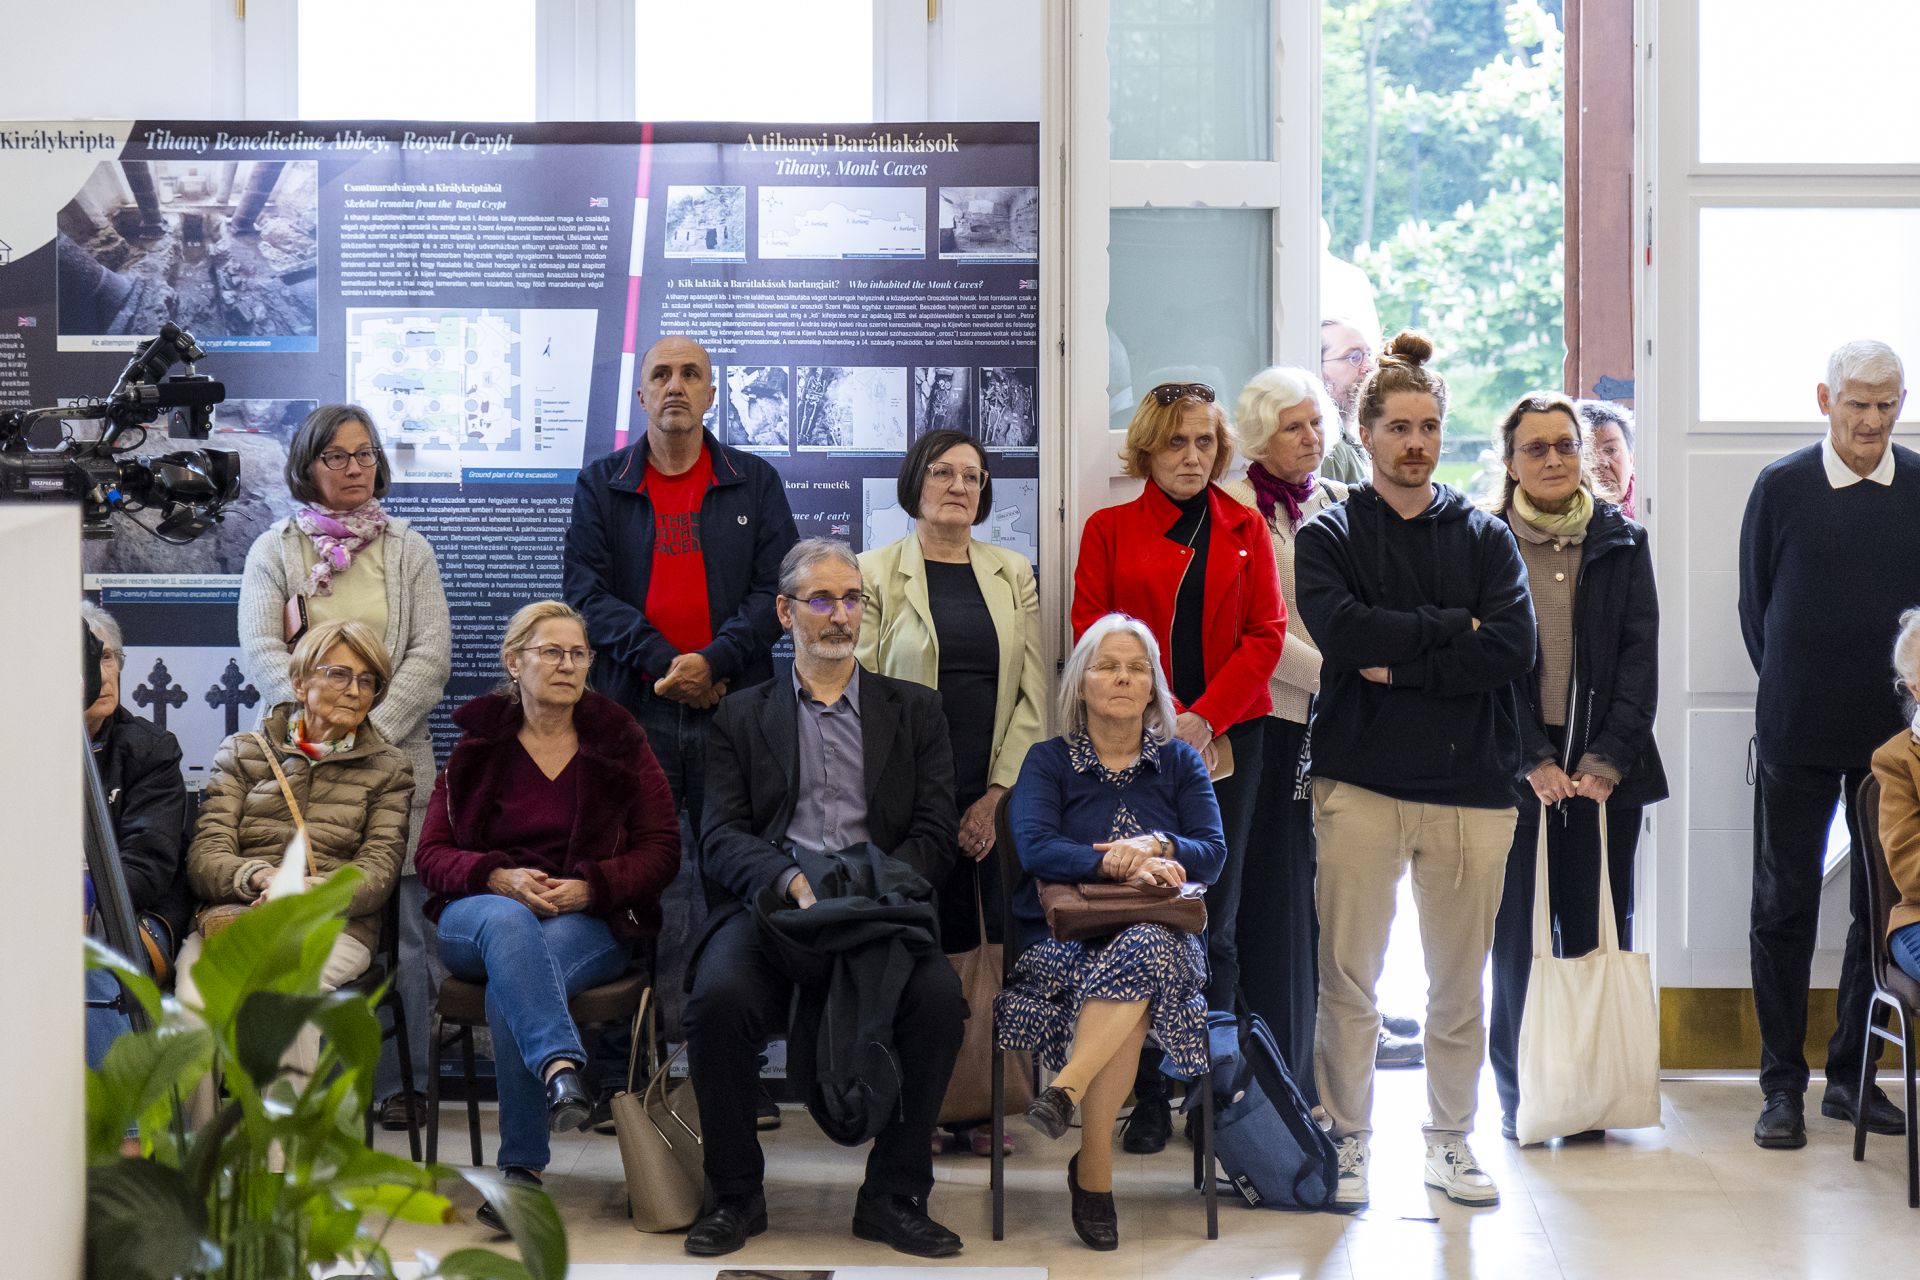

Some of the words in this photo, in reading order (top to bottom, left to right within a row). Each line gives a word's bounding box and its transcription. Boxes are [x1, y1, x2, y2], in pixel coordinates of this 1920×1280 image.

[0, 129, 115, 153] Királykripta
[144, 128, 209, 153] Tihany
[214, 129, 326, 152] Benedictine
[328, 130, 390, 153] Abbey,
[401, 131, 455, 154] Royal
[459, 131, 513, 154] Crypt
[742, 134, 759, 152] A
[761, 132, 830, 156] tihanyi
[834, 132, 960, 153] Barátlakások
[775, 157, 830, 178] Tihany,
[835, 159, 879, 175] Monk
[883, 160, 928, 176] Caves
[344, 182, 427, 193] Csontmaradványok
[436, 182, 502, 194] Királykriptából
[344, 198, 378, 208] Skeletal
[379, 198, 414, 208] remains
[415, 199, 436, 209] from
[438, 199, 452, 208] the
[455, 199, 480, 210] Royal
[481, 200, 506, 210] Crypt
[667, 279, 673, 288] 1)
[678, 279, 693, 288] Kik
[694, 278, 722, 288] lakták
[730, 278, 786, 288] Barátlakások
[788, 279, 840, 290] barlangjait?
[849, 280, 868, 288] Who
[869, 280, 910, 288] inhabited
[912, 280, 925, 288] the
[928, 280, 951, 288] Monk
[953, 280, 983, 288] Caves?
[468, 470, 492, 478] Ground
[491, 471, 506, 479] plan
[785, 480, 809, 489] korai
[813, 480, 851, 489] remeték
[658, 511, 689, 526] THE
[814, 512, 825, 522] of
[827, 512, 851, 522] early
[654, 538, 690, 556] FACE
